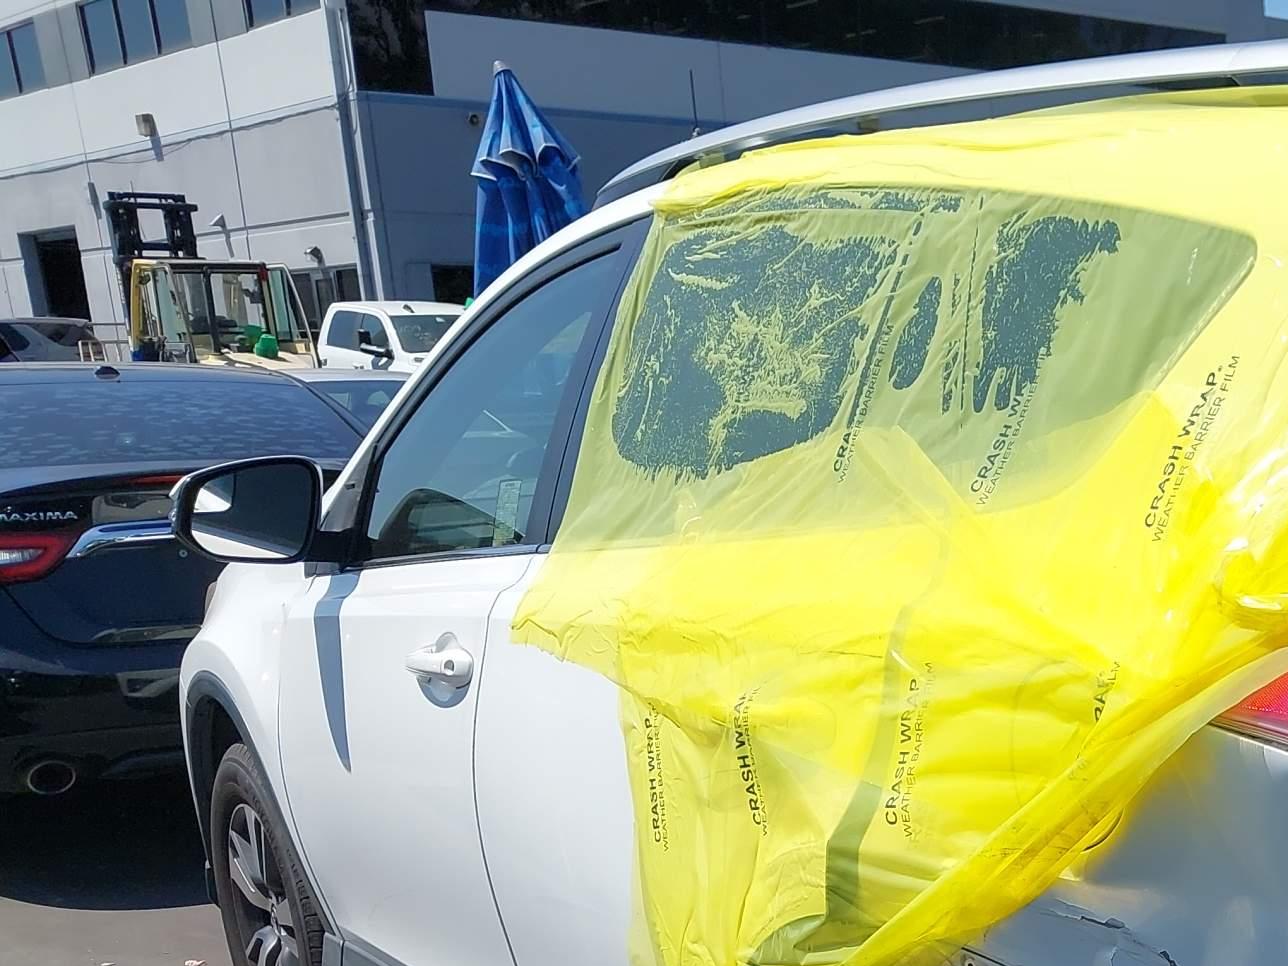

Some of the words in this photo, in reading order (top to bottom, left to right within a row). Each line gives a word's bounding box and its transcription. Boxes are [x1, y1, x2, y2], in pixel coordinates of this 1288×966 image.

[970, 424, 1013, 494] CRASH
[976, 440, 1014, 506] WEATHER
[1151, 465, 1190, 543] WEATHER
[1183, 395, 1226, 462] BARRIER
[1219, 355, 1241, 394] FILM
[1144, 445, 1184, 528] CRASH
[885, 750, 911, 826] CRASH
[899, 678, 920, 745] WRAP
[648, 778, 662, 843] CRASH
[736, 755, 762, 826] CRASH
[900, 764, 917, 838] WEATHER
